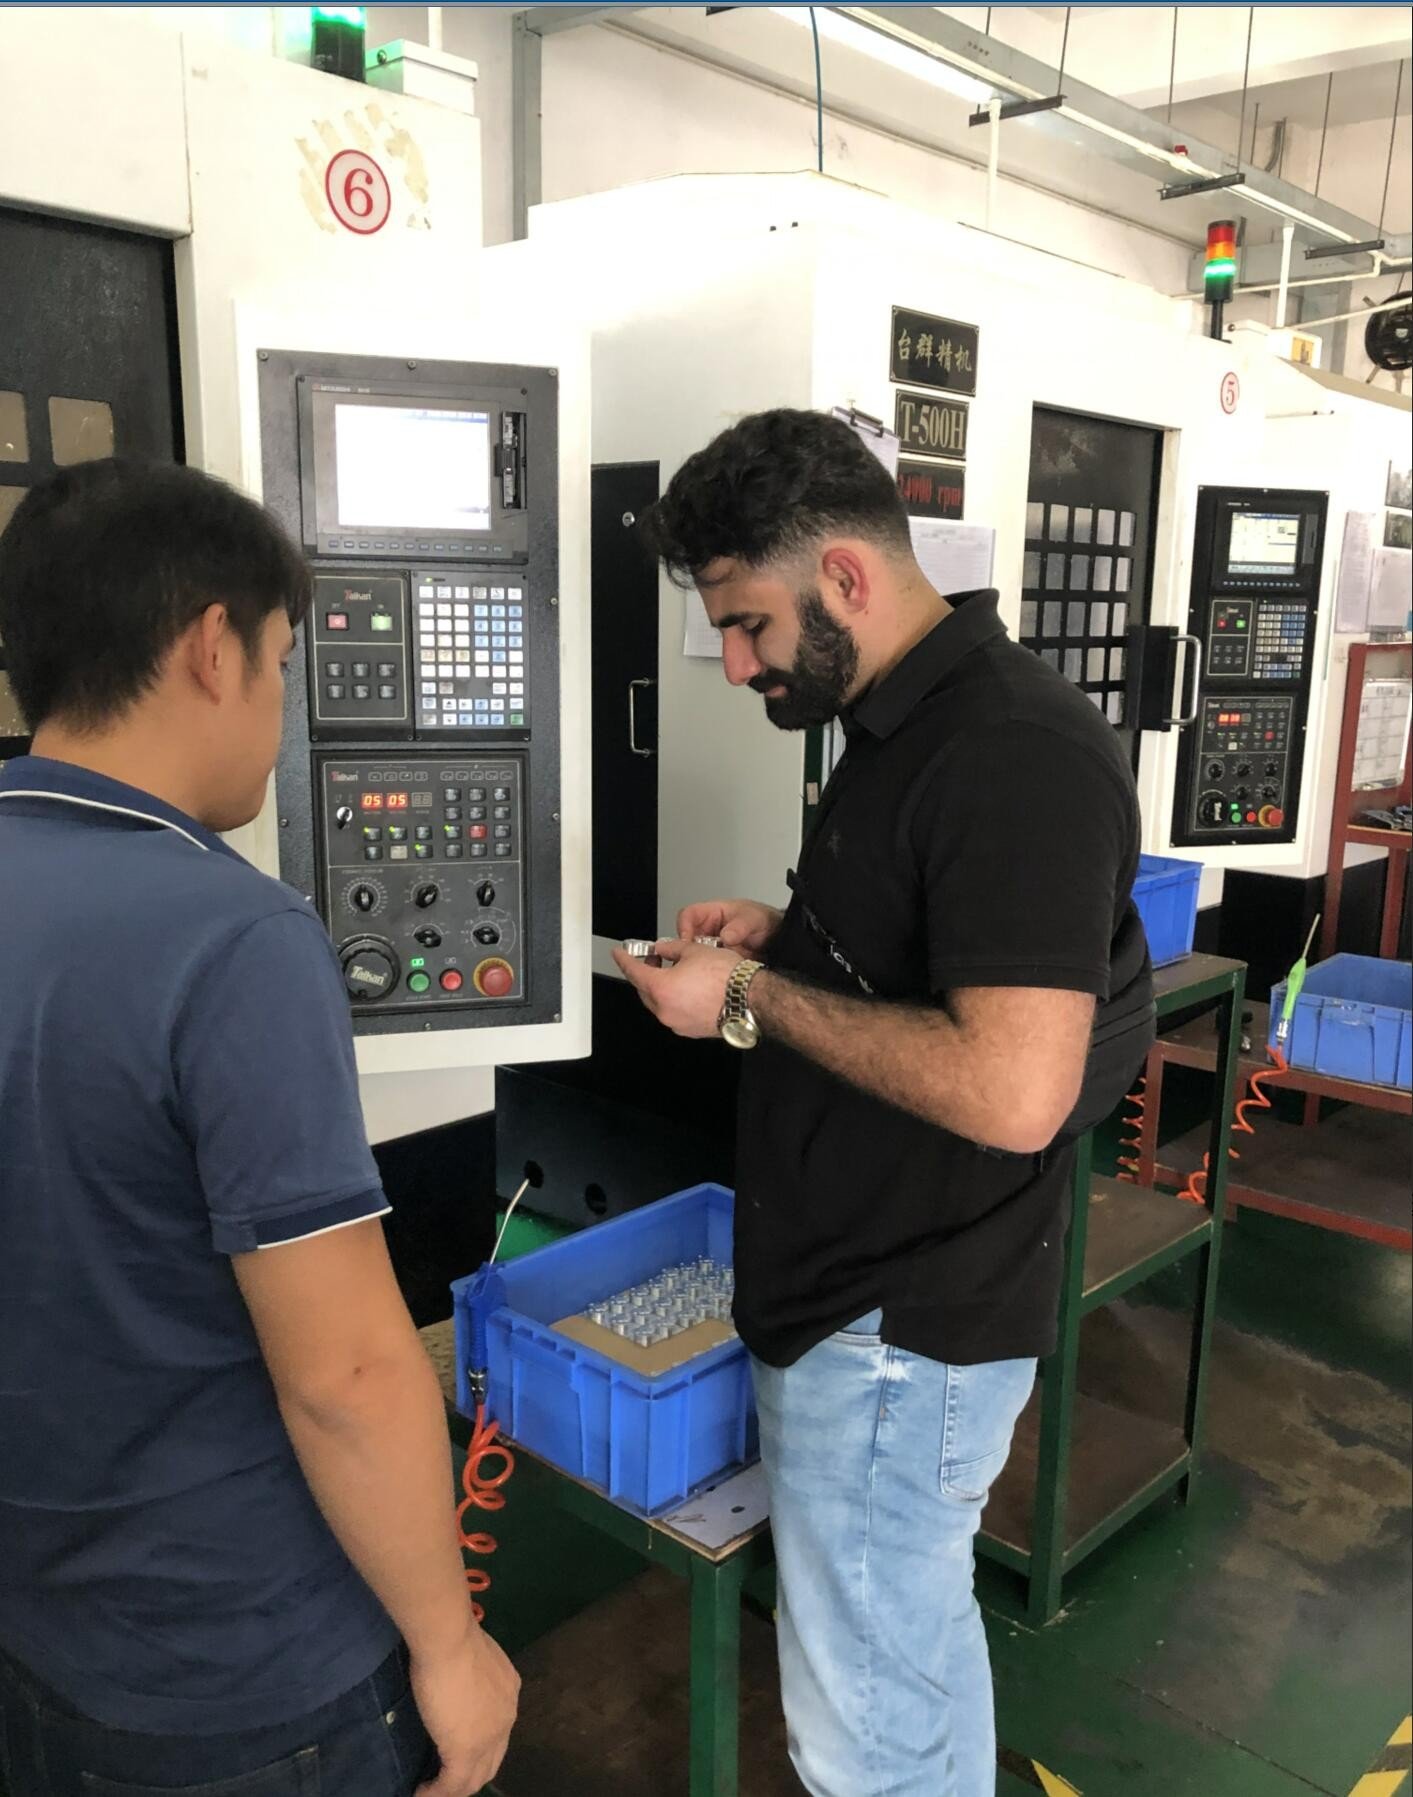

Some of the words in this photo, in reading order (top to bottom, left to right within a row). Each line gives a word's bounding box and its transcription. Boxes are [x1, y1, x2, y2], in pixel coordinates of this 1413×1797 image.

[343, 168, 373, 216] 6
[898, 329, 972, 370] 台群精机
[1226, 380, 1235, 407] 5
[901, 402, 965, 449] T-500H
[938, 486, 961, 512] rpm
